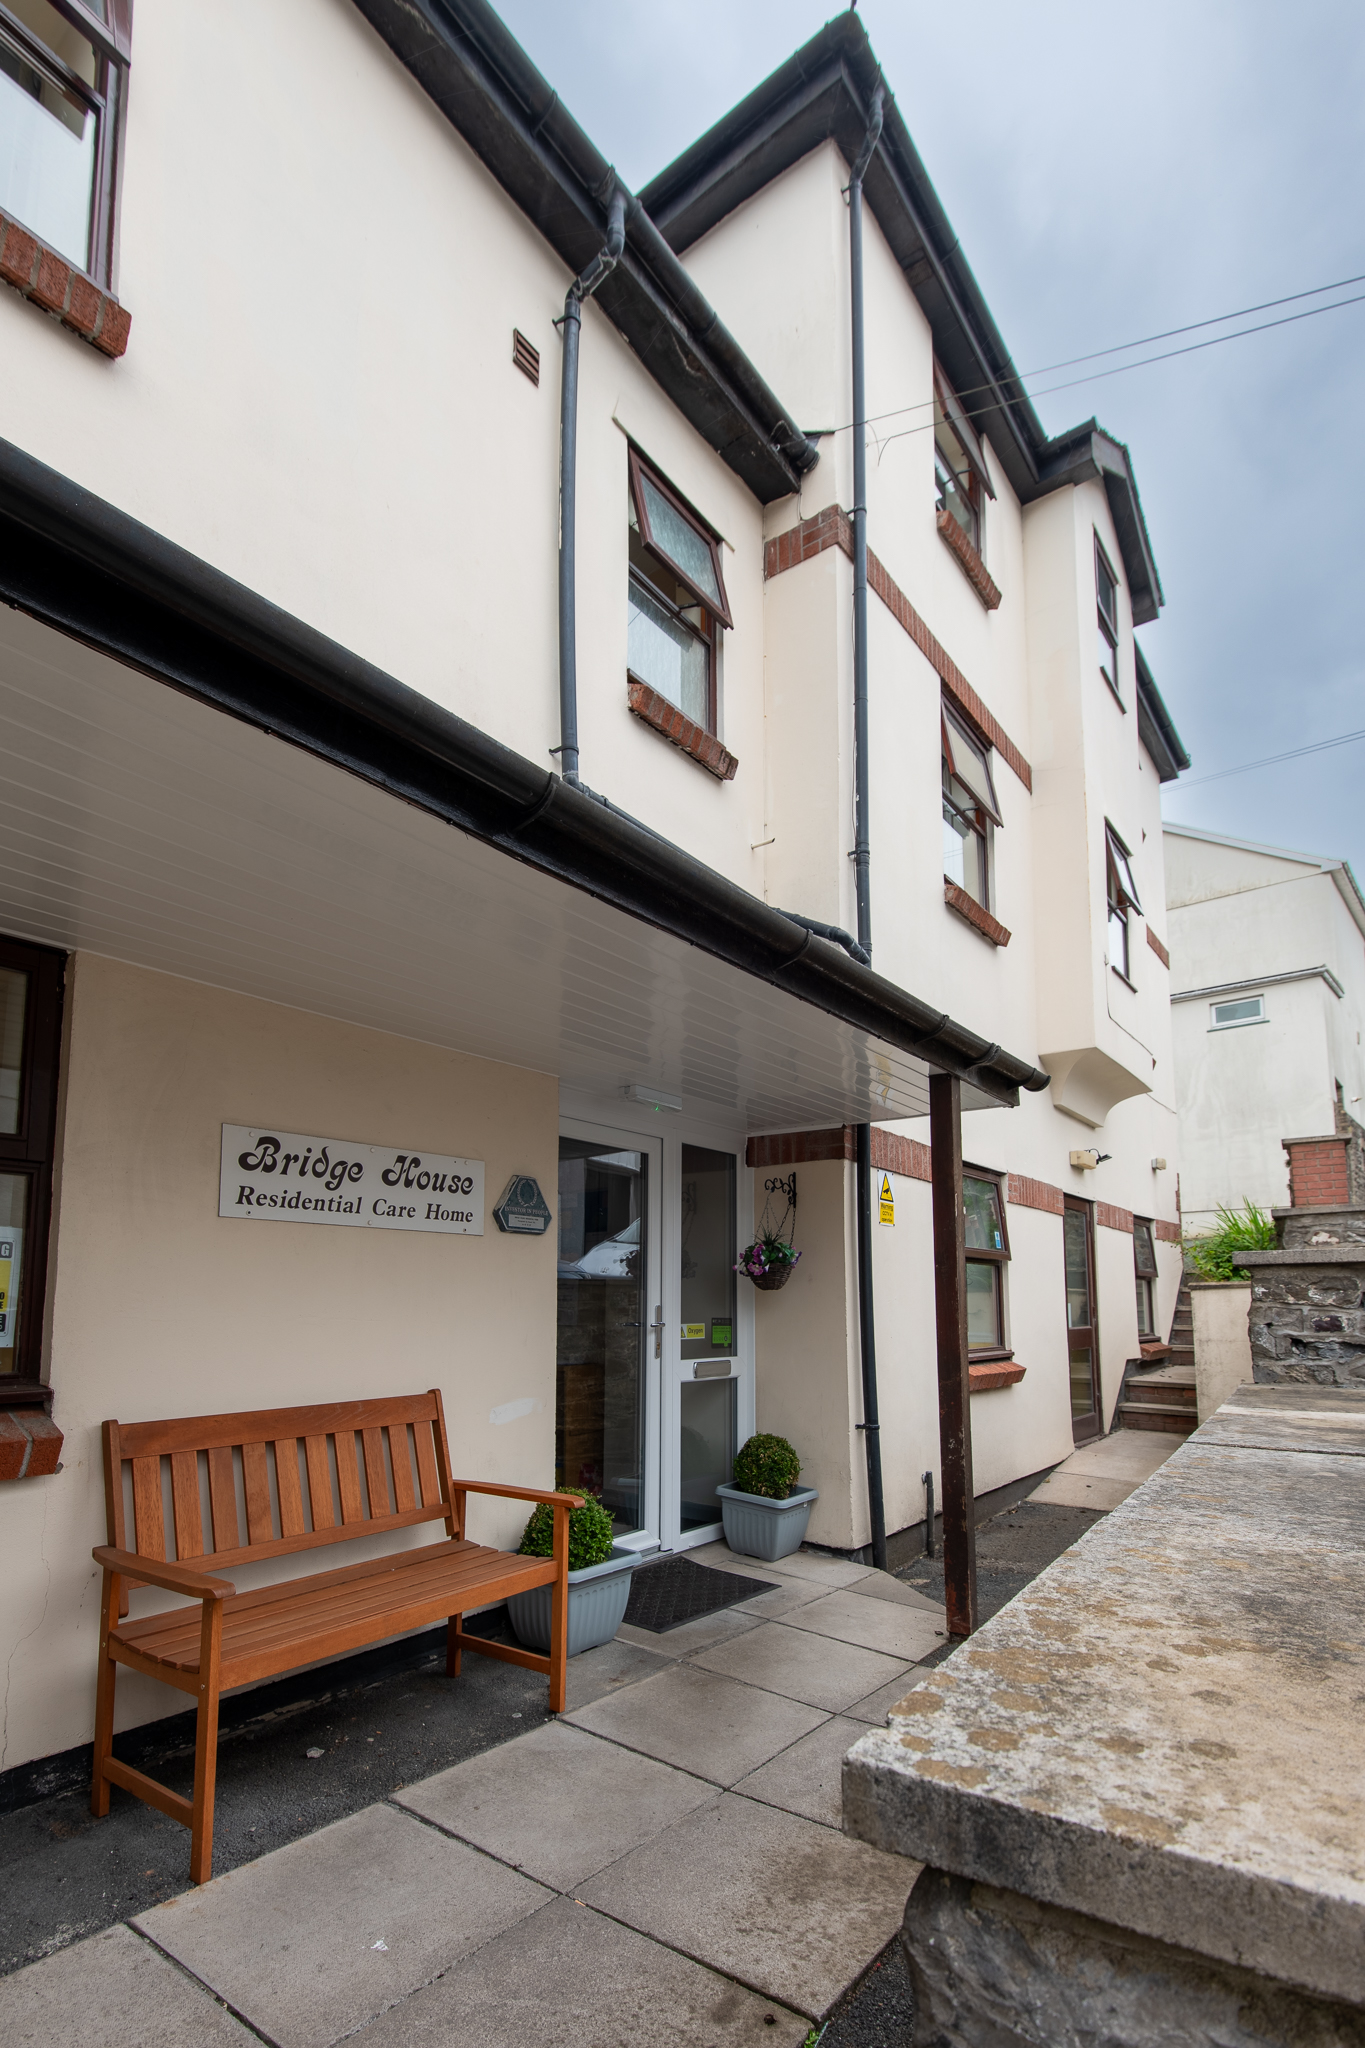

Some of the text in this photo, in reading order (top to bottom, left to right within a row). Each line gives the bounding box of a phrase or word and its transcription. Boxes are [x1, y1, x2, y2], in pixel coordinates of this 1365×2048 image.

[238, 1136, 475, 1196] Bridge House
[235, 1185, 474, 1223] Residential Care Home
